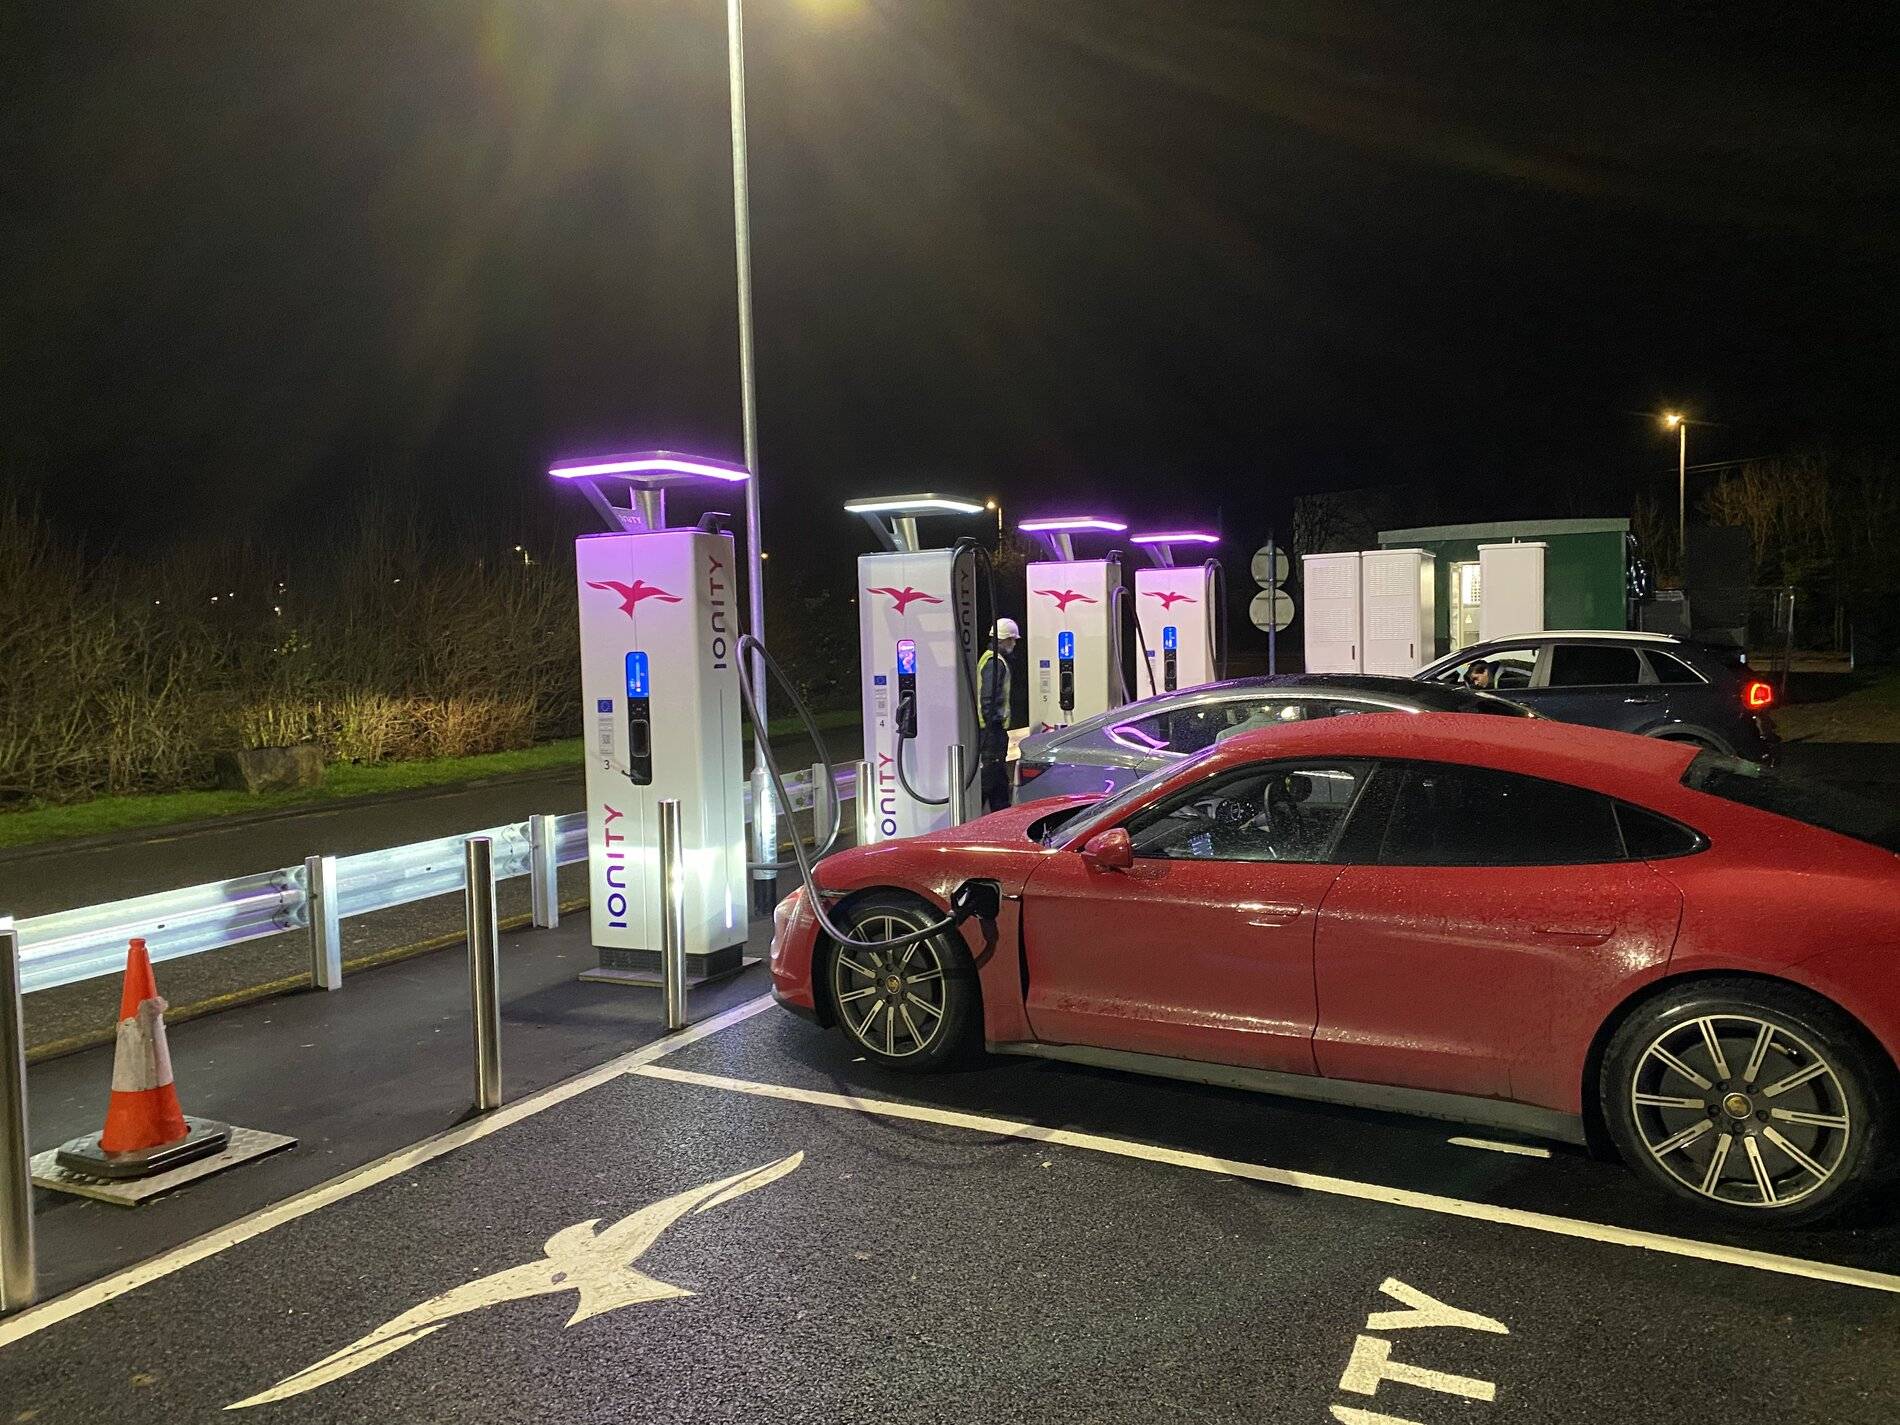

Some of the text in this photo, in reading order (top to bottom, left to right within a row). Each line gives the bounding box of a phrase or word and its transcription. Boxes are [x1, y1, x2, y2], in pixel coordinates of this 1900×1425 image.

[708, 555, 727, 669] IONITY
[603, 760, 610, 770] 3
[879, 719, 885, 727] 4
[878, 752, 897, 836] ONITY
[604, 803, 628, 928] IONITY
